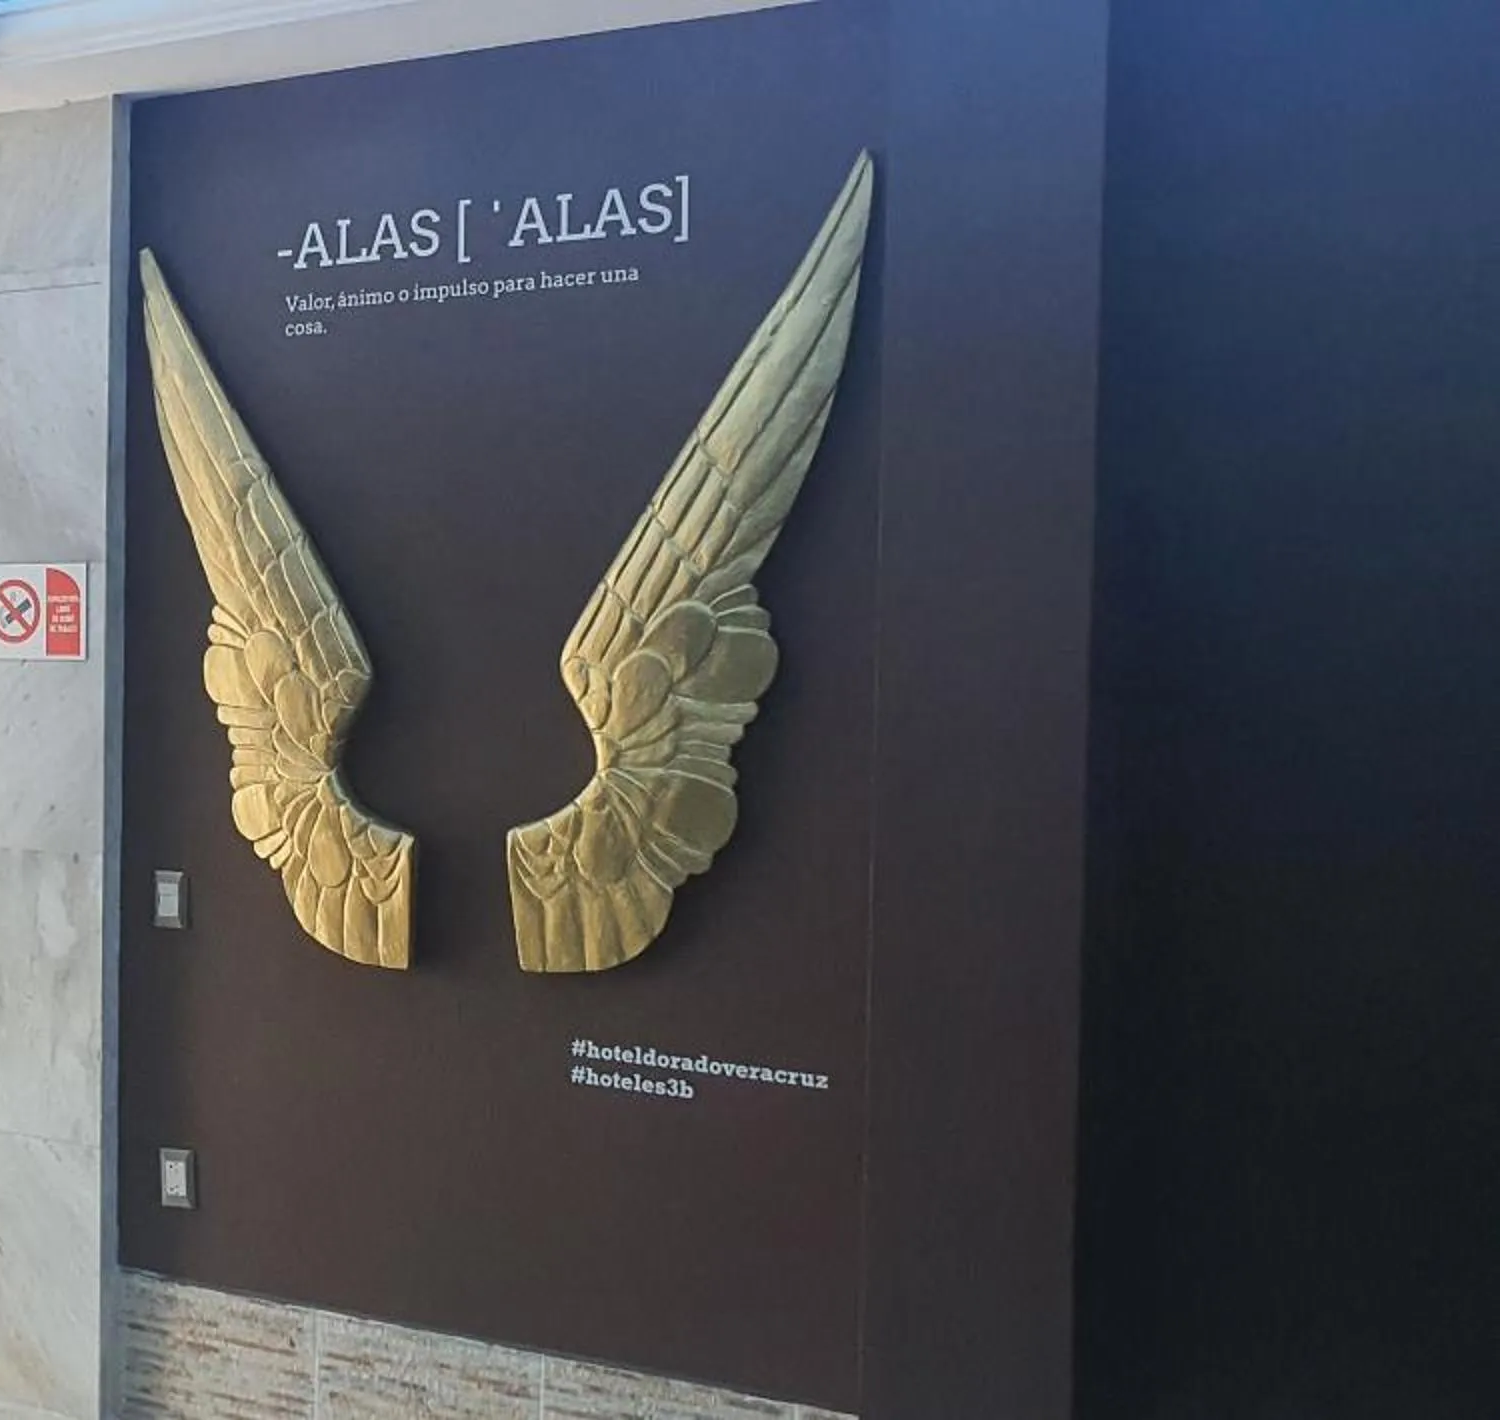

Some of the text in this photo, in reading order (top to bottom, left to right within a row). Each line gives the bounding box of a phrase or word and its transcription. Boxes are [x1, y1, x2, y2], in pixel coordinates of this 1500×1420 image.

[286, 266, 640, 313] Valor, ánimo o impulso para hacer una
[284, 319, 327, 337] cosa.
[570, 1065, 694, 1099] #hoteles3b
[571, 1038, 829, 1089] #hoteldoradoveracruz
